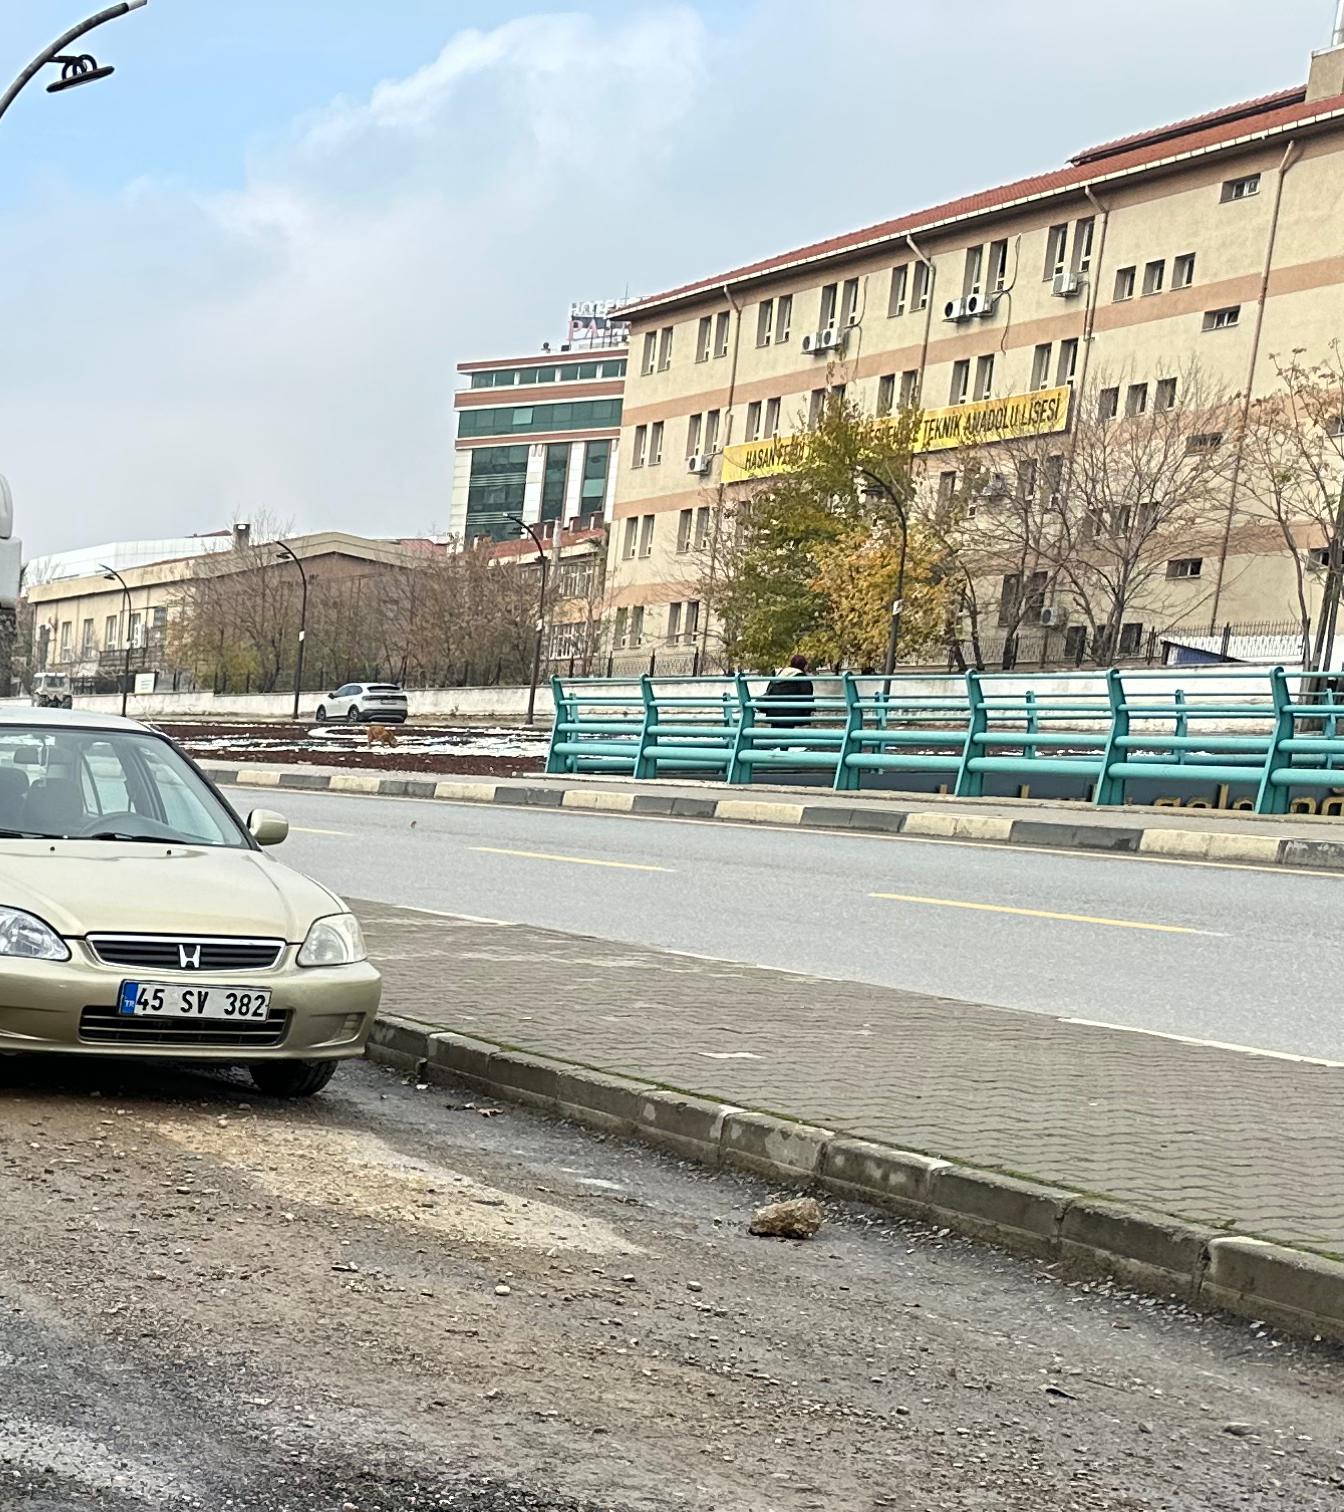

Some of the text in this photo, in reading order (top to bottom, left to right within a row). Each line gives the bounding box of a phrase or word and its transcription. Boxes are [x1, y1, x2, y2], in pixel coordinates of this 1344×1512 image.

[924, 410, 962, 443] TEKNİK
[963, 402, 1019, 436] ANADOLU
[1021, 391, 1062, 426] LİSESİ
[136, 987, 165, 1012] 45
[179, 990, 209, 1014] SV
[223, 992, 266, 1018] 382
